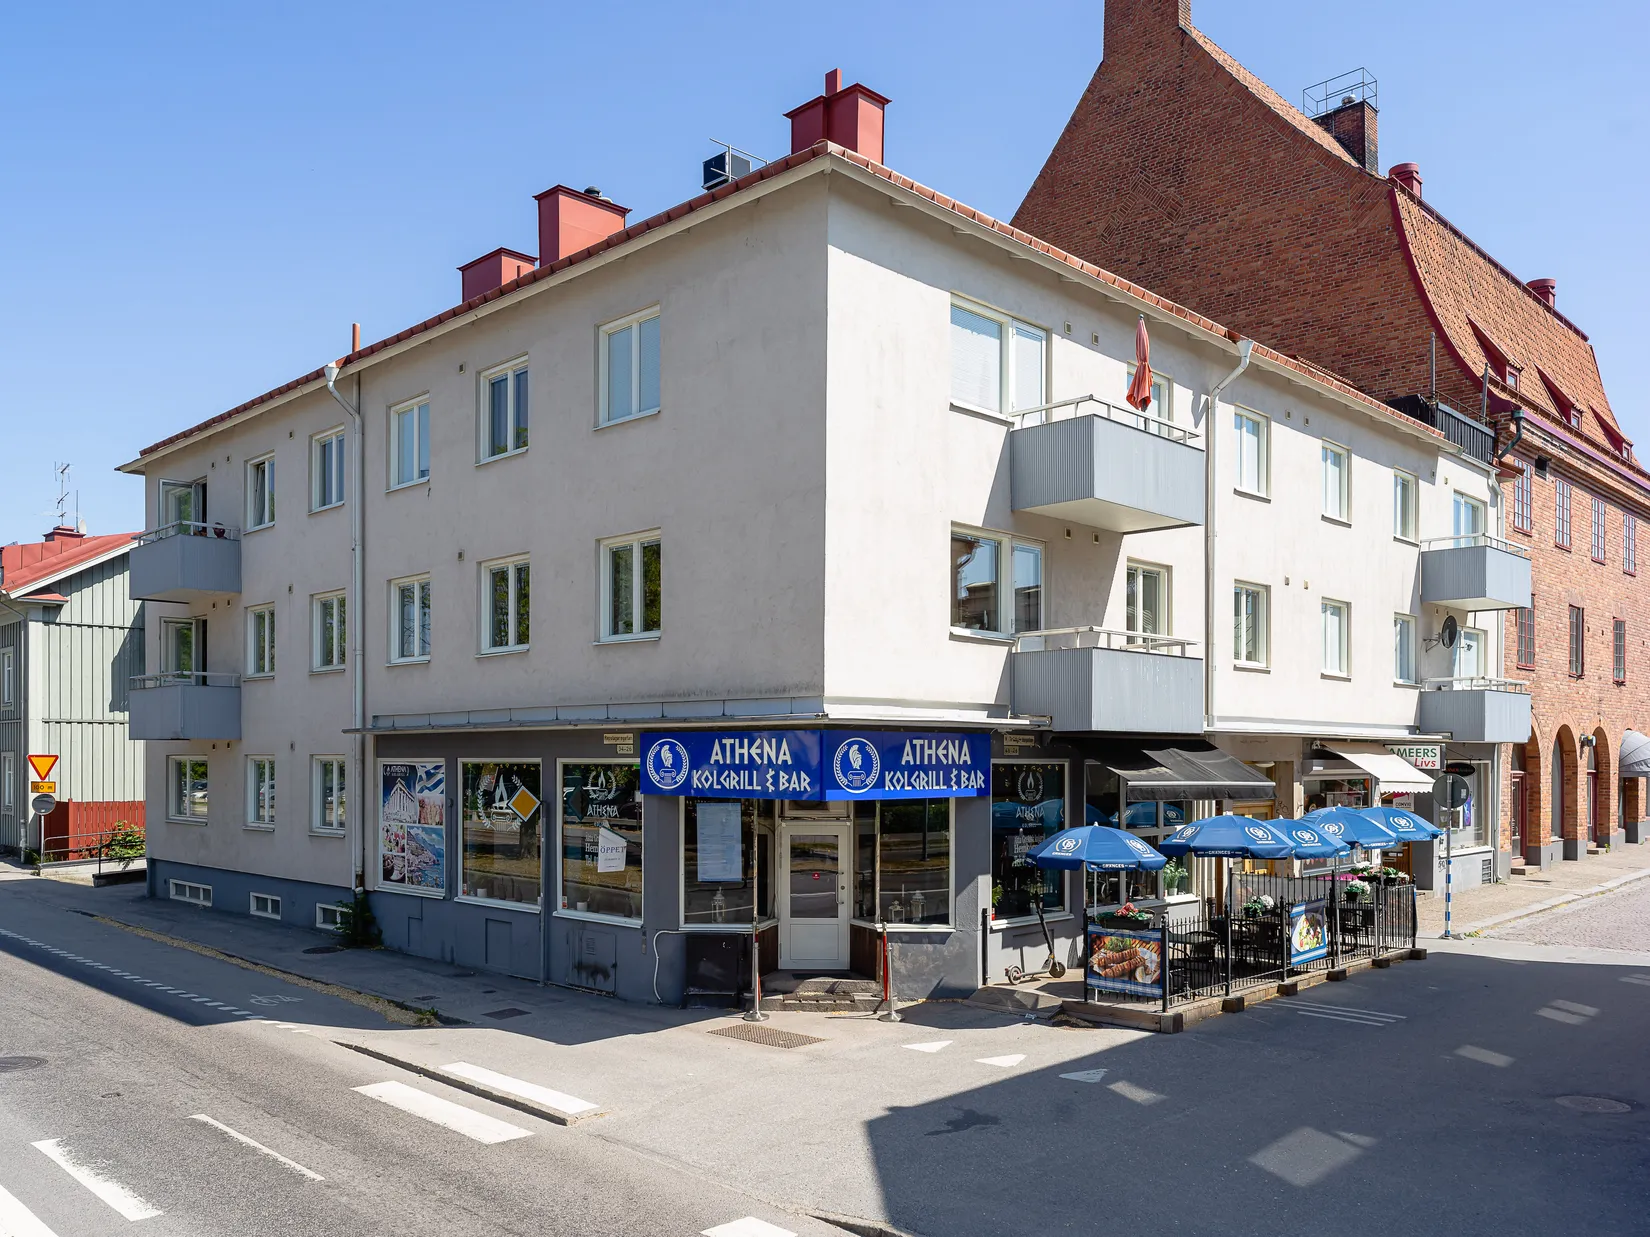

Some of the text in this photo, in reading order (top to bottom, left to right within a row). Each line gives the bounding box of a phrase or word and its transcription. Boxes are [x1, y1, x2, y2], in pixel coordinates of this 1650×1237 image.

[710, 737, 792, 765] ATHENA
[901, 739, 971, 766] ATHENA
[1414, 757, 1437, 767] Livs
[692, 768, 811, 792] KOLGRILL & BAR
[884, 768, 985, 791] KOLGRILL & BAR
[586, 803, 620, 818] ATHENA
[1015, 806, 1045, 819] ATHENA
[600, 845, 627, 854] ÖPPET
